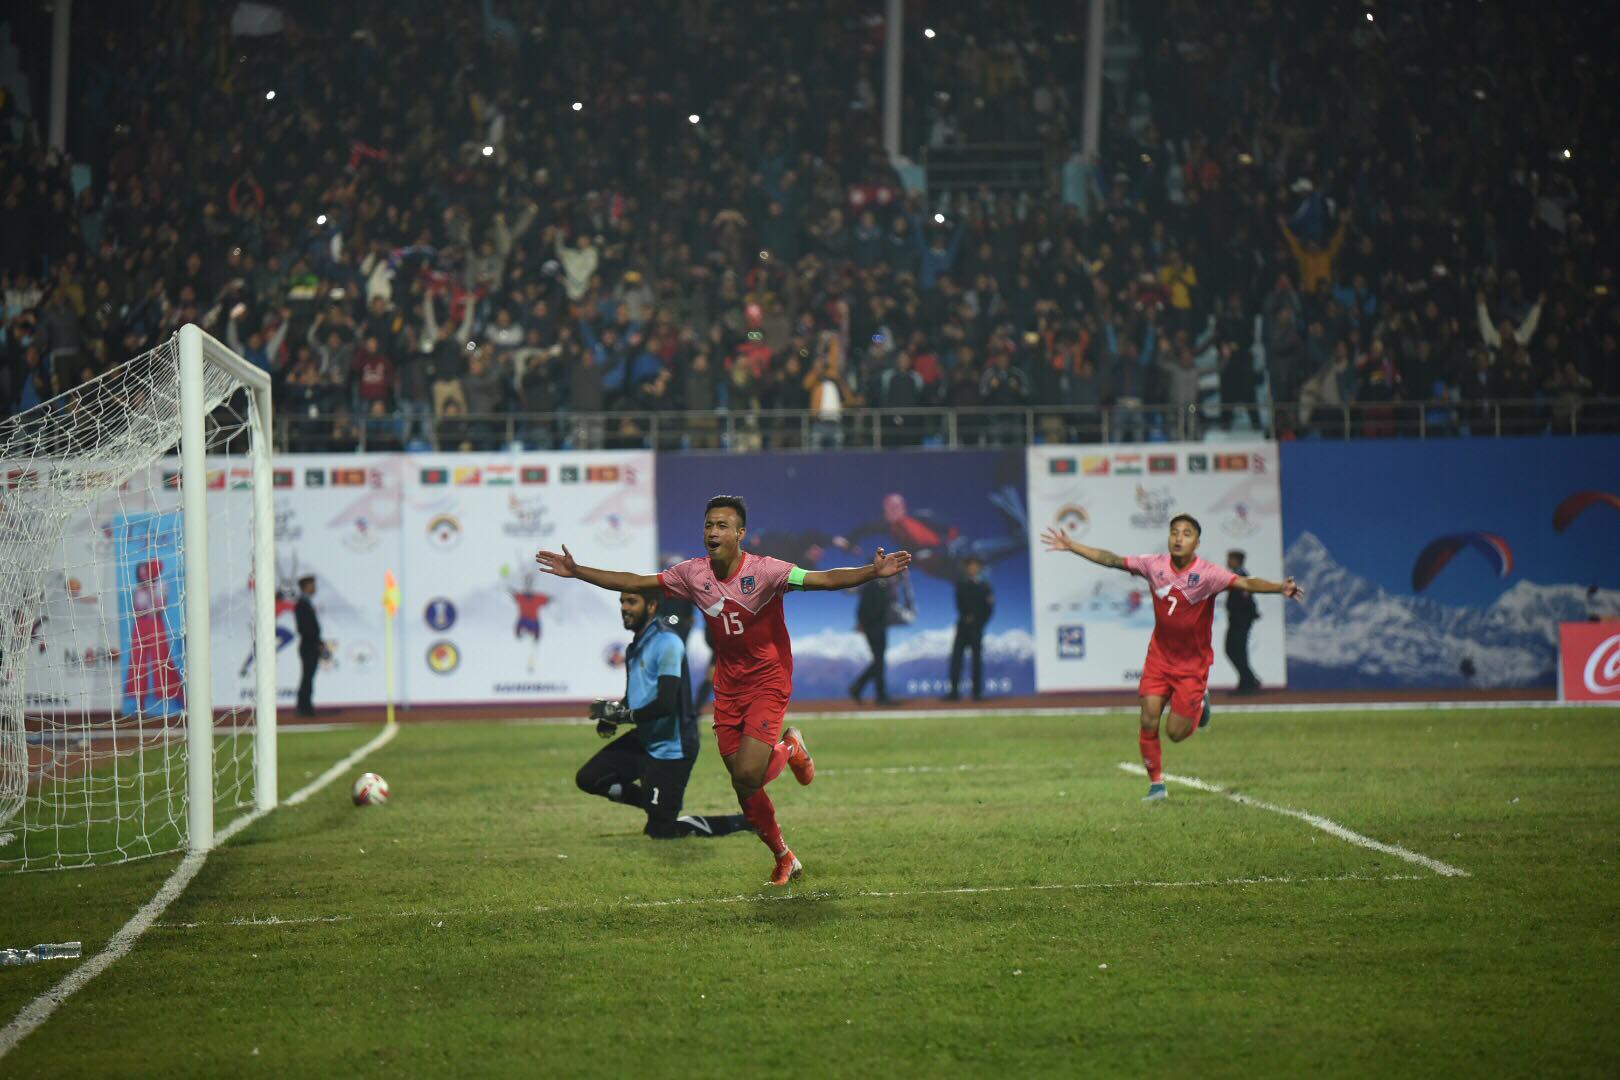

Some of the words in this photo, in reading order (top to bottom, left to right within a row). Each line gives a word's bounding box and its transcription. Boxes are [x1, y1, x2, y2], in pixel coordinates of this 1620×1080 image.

[1167, 595, 1178, 617] 7
[721, 611, 744, 635] 15
[650, 786, 660, 805] 1
